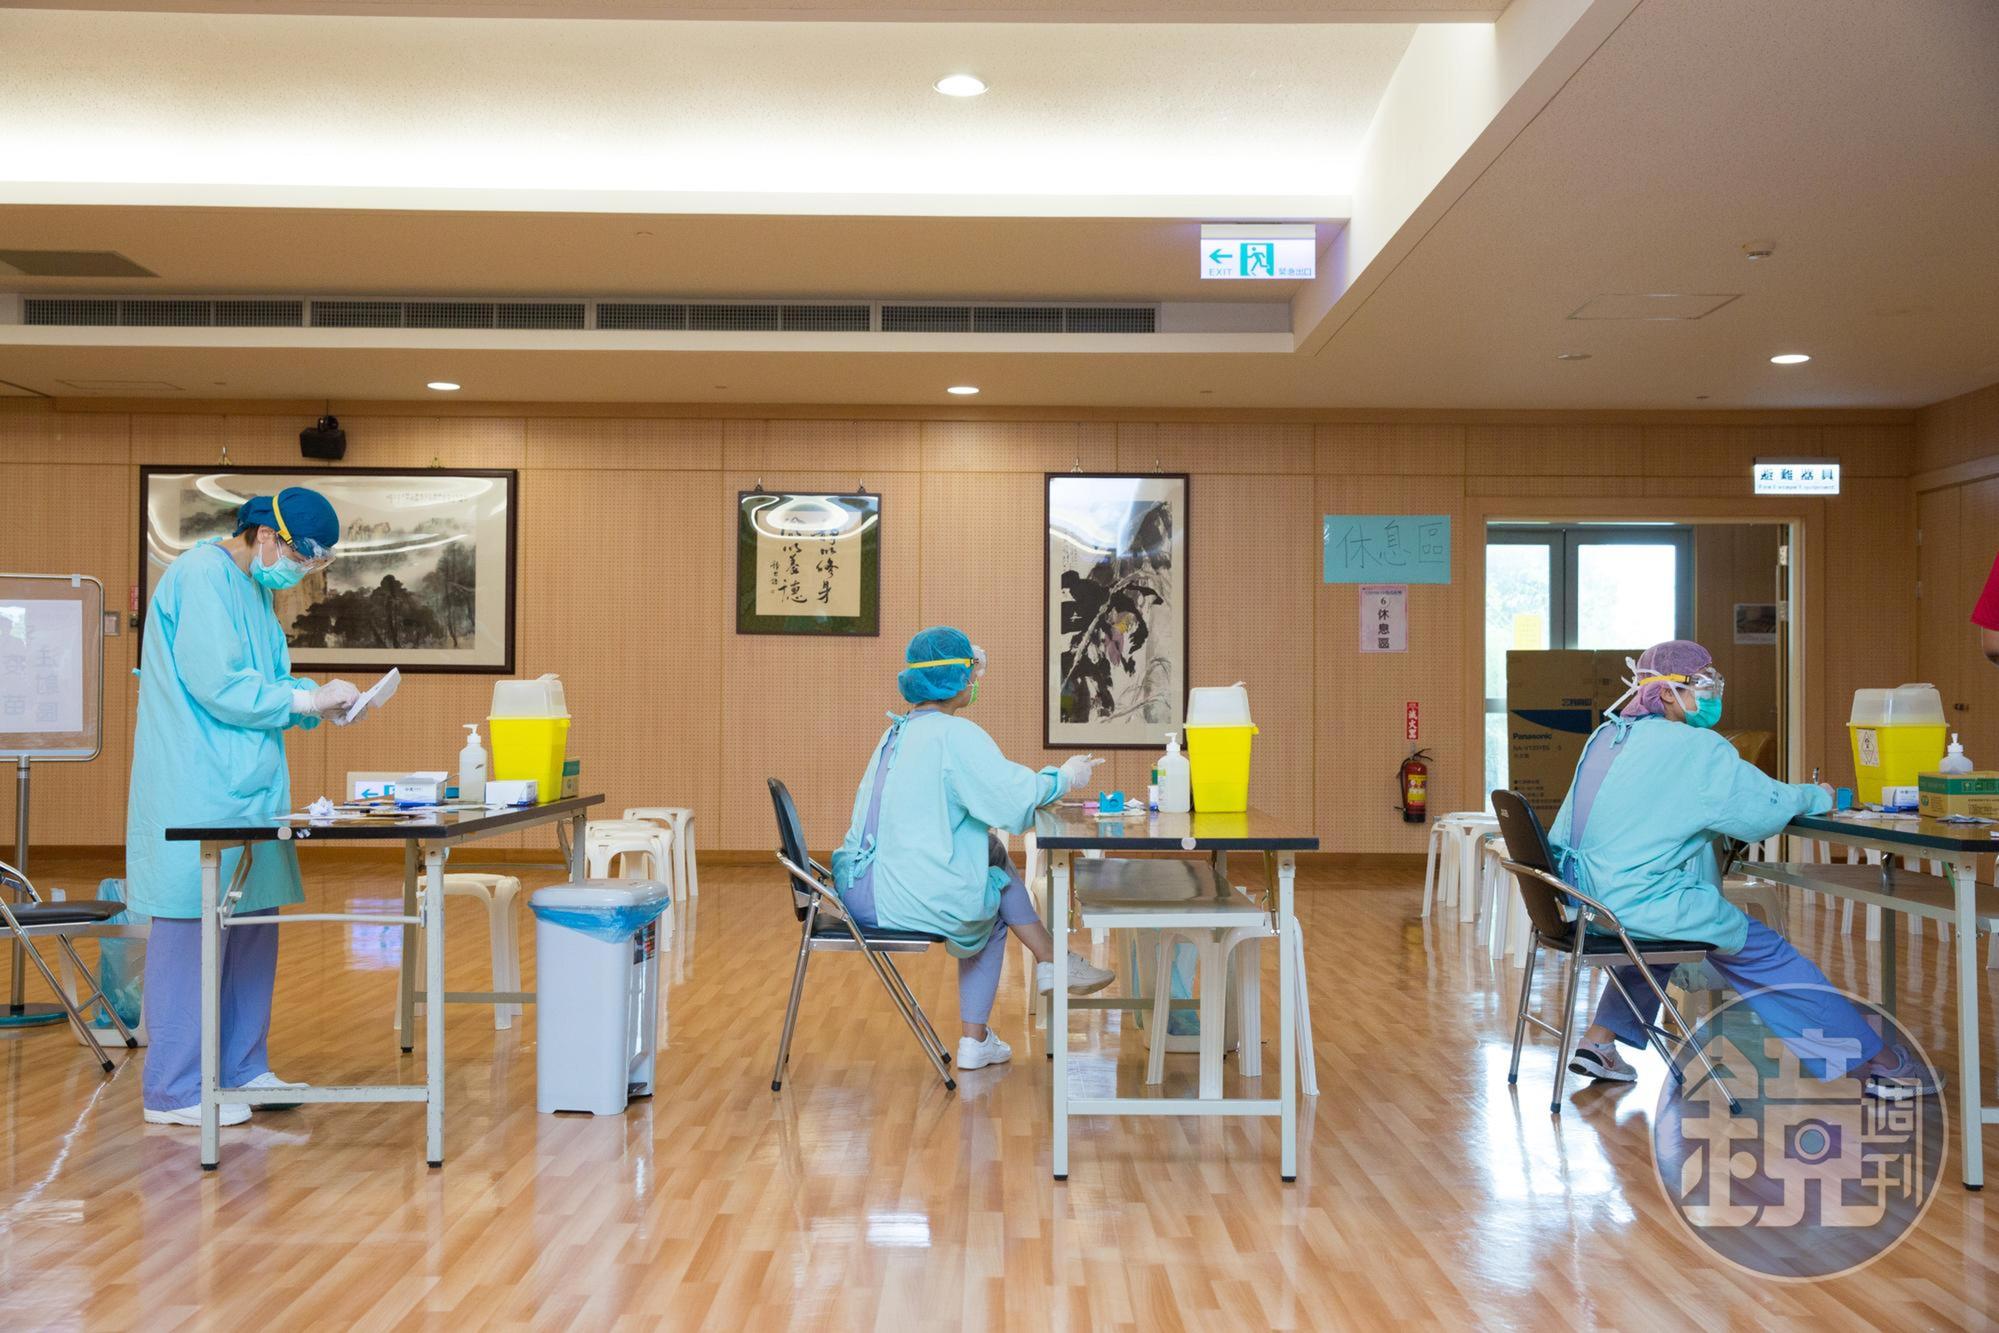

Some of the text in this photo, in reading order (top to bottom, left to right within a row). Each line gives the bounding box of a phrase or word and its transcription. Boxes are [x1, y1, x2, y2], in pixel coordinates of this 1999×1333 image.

[1209, 268, 1231, 276] EXIT
[1279, 267, 1311, 276] 緊急出口
[1336, 519, 1445, 568] 休息區
[1378, 608, 1390, 649] 休息區
